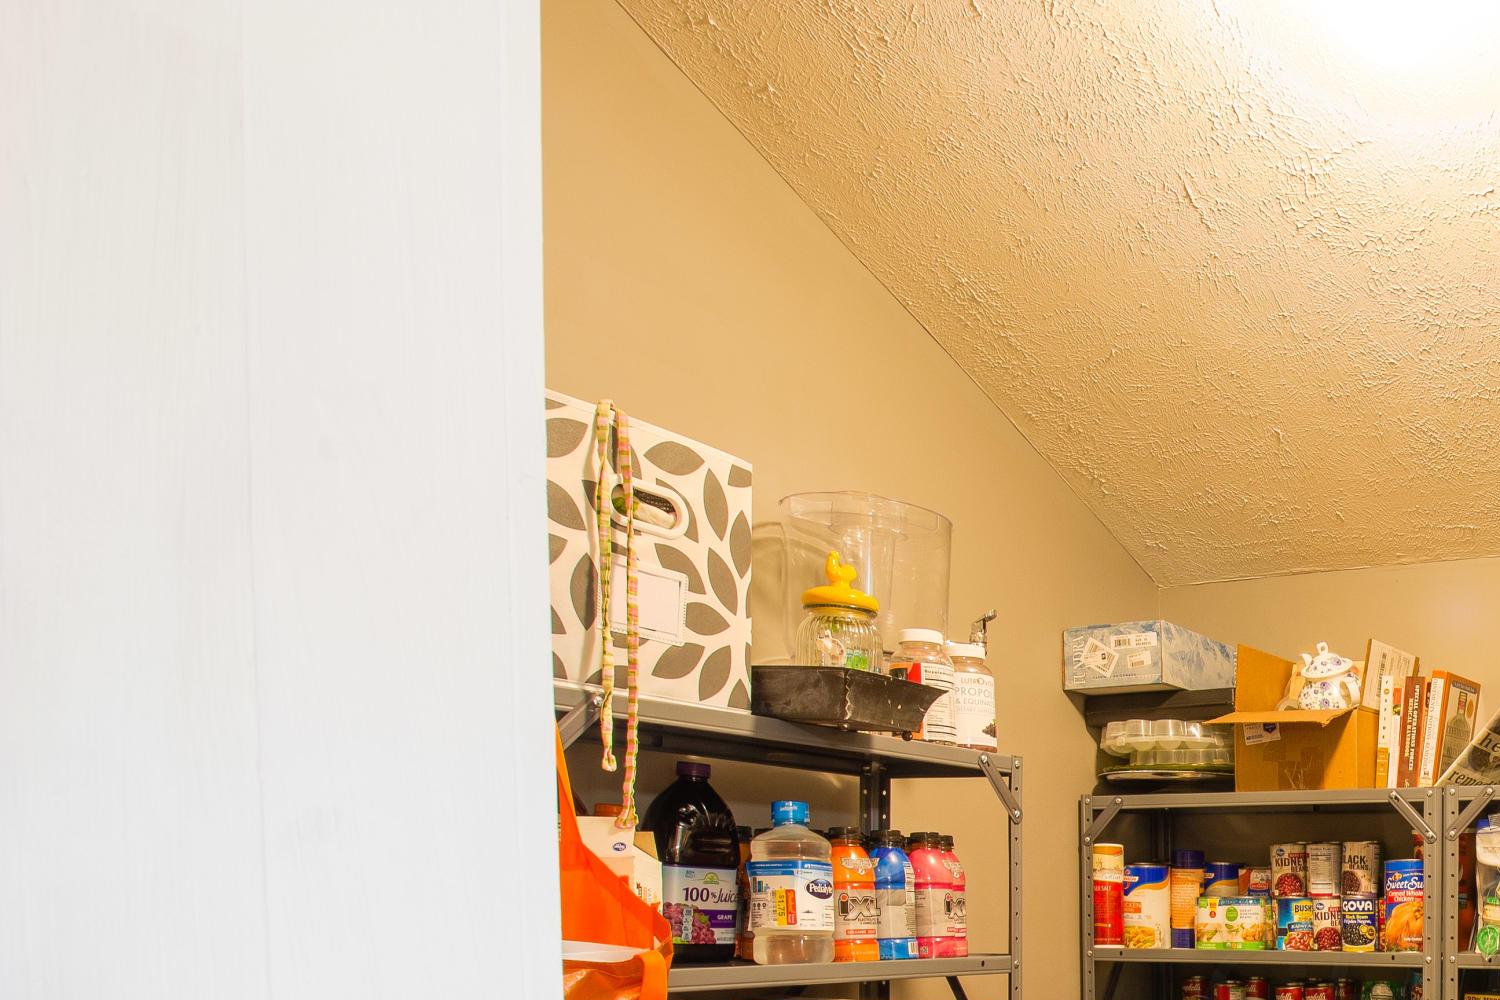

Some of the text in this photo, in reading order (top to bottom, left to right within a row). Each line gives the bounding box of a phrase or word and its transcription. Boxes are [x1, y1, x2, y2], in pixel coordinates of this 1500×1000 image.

[1343, 855, 1367, 865] LACK
[1343, 901, 1373, 911] GOYA
[1314, 911, 1341, 921] KIDNE
